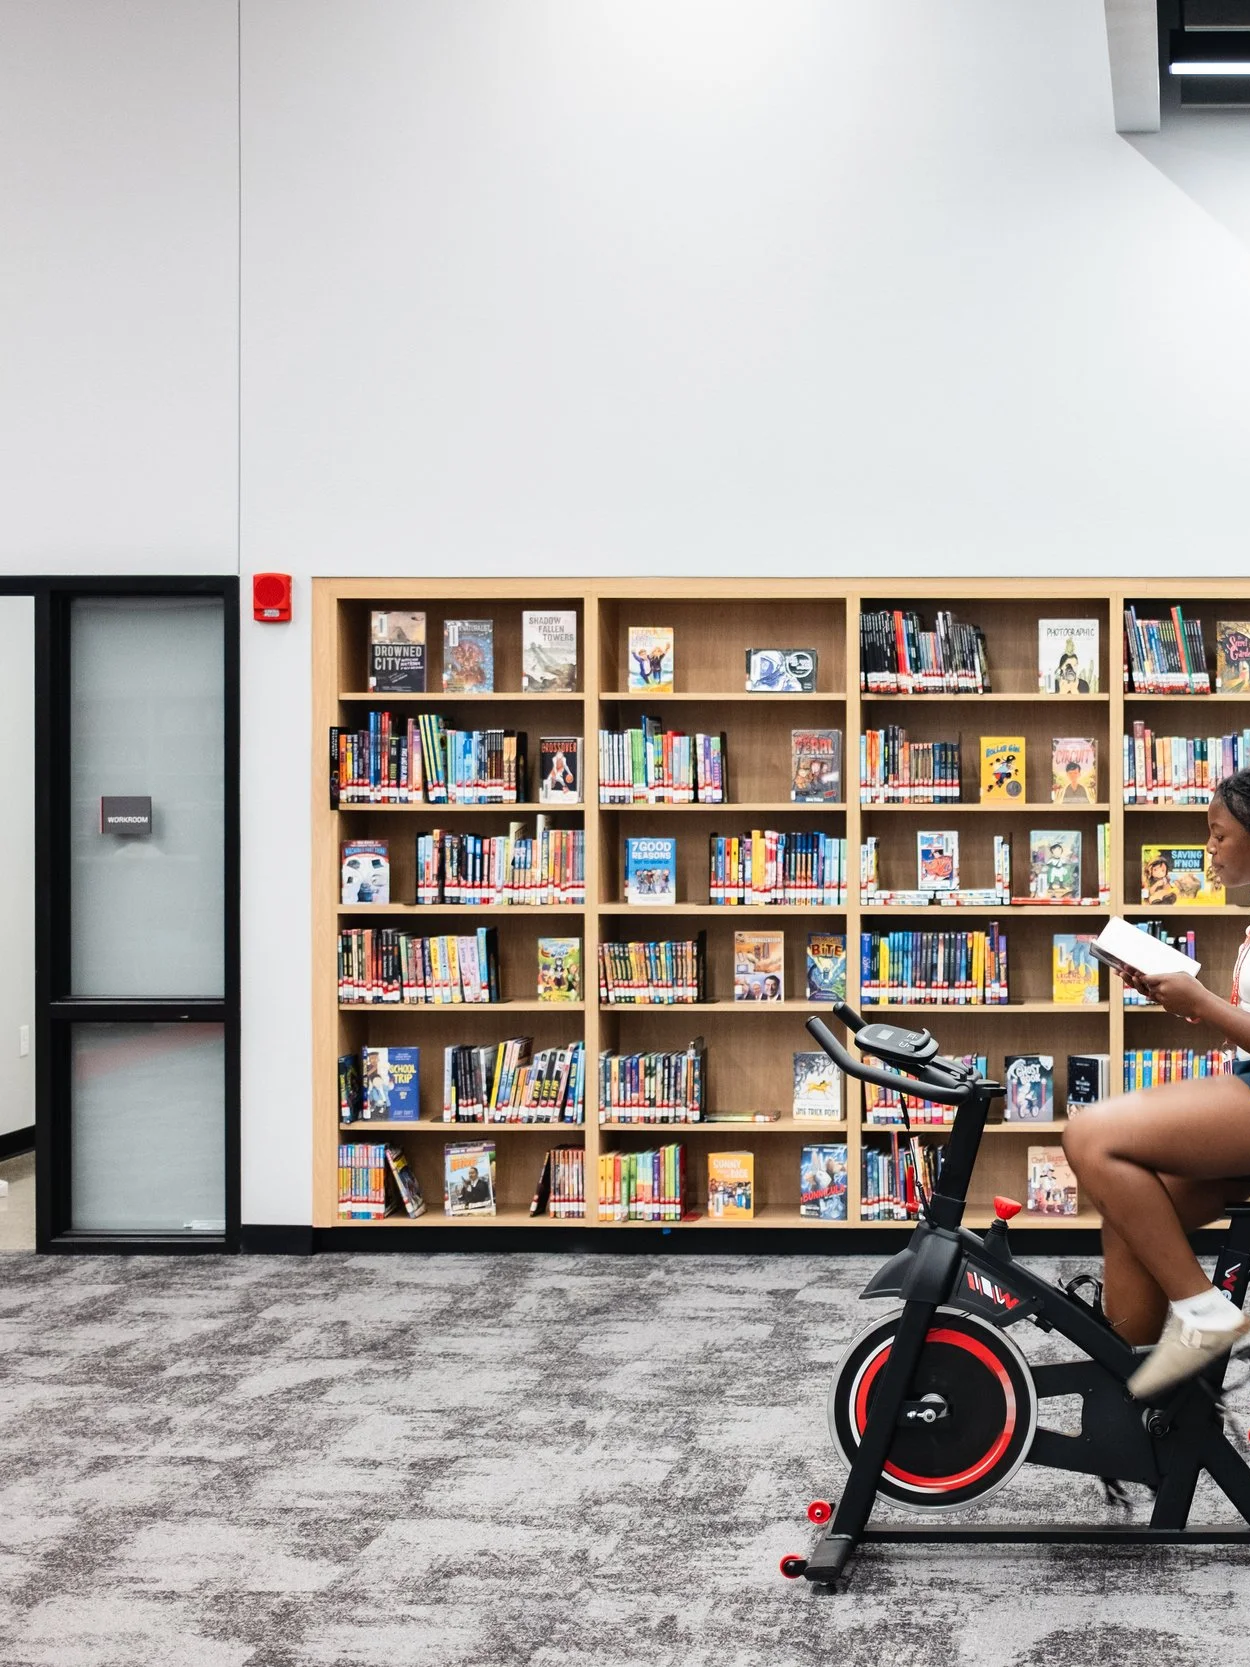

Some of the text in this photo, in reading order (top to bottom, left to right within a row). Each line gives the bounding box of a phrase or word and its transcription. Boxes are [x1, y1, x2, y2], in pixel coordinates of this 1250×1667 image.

[529, 616, 561, 625] SHADOW
[538, 625, 565, 633] FALLEN
[1046, 627, 1095, 637] PHOTOGRAPHIC
[543, 634, 575, 642] TOWERS
[374, 646, 422, 657] DROWNED
[374, 657, 401, 671] CITY
[541, 742, 577, 753] CROSSOVER
[632, 841, 672, 852] 7 GOOD
[631, 851, 672, 860] REASONS
[1171, 850, 1203, 860] SAVING
[388, 1063, 417, 1075] SCHOOL
[393, 1073, 413, 1084] TRIP
[802, 1184, 846, 1203] BUNNICULA
